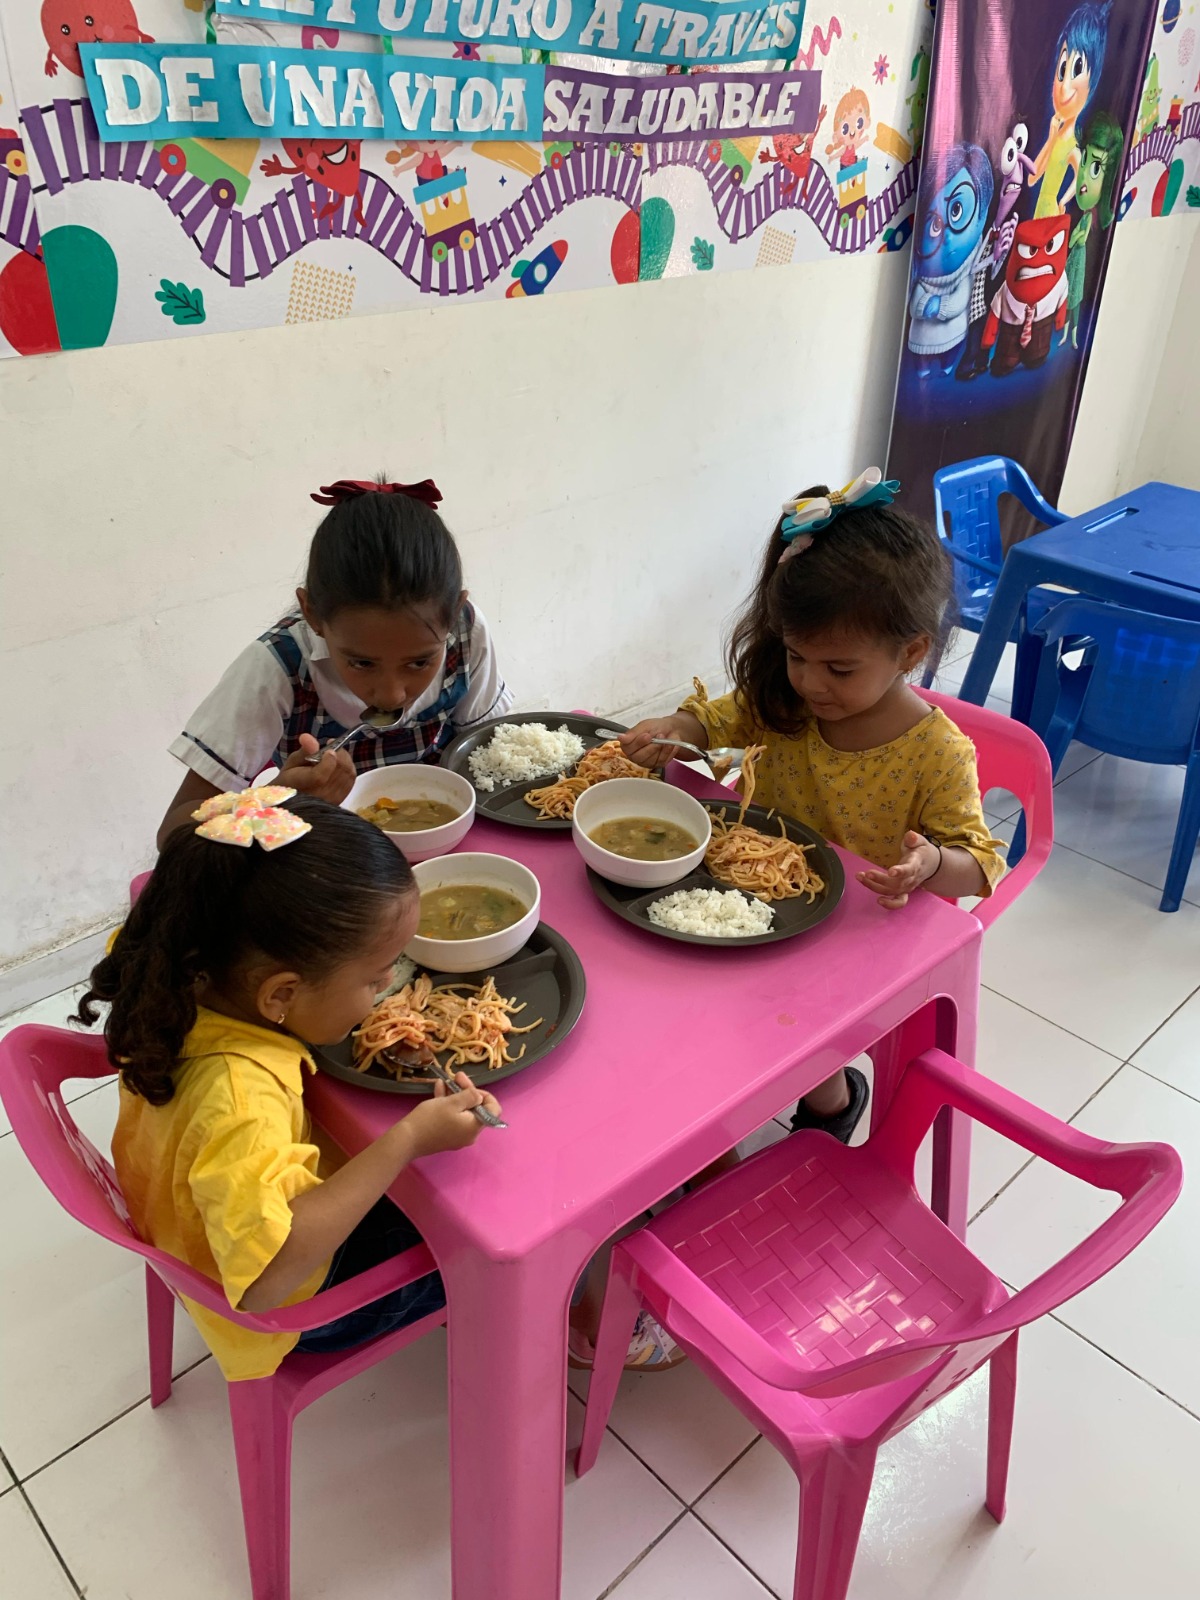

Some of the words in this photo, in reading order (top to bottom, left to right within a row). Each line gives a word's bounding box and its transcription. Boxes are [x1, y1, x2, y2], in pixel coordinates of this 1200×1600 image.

[578, 0, 623, 50] A
[95, 57, 219, 126] DE
[238, 61, 384, 128] UNA
[389, 71, 528, 132] VIDA
[543, 79, 801, 135] SALUDABLE
